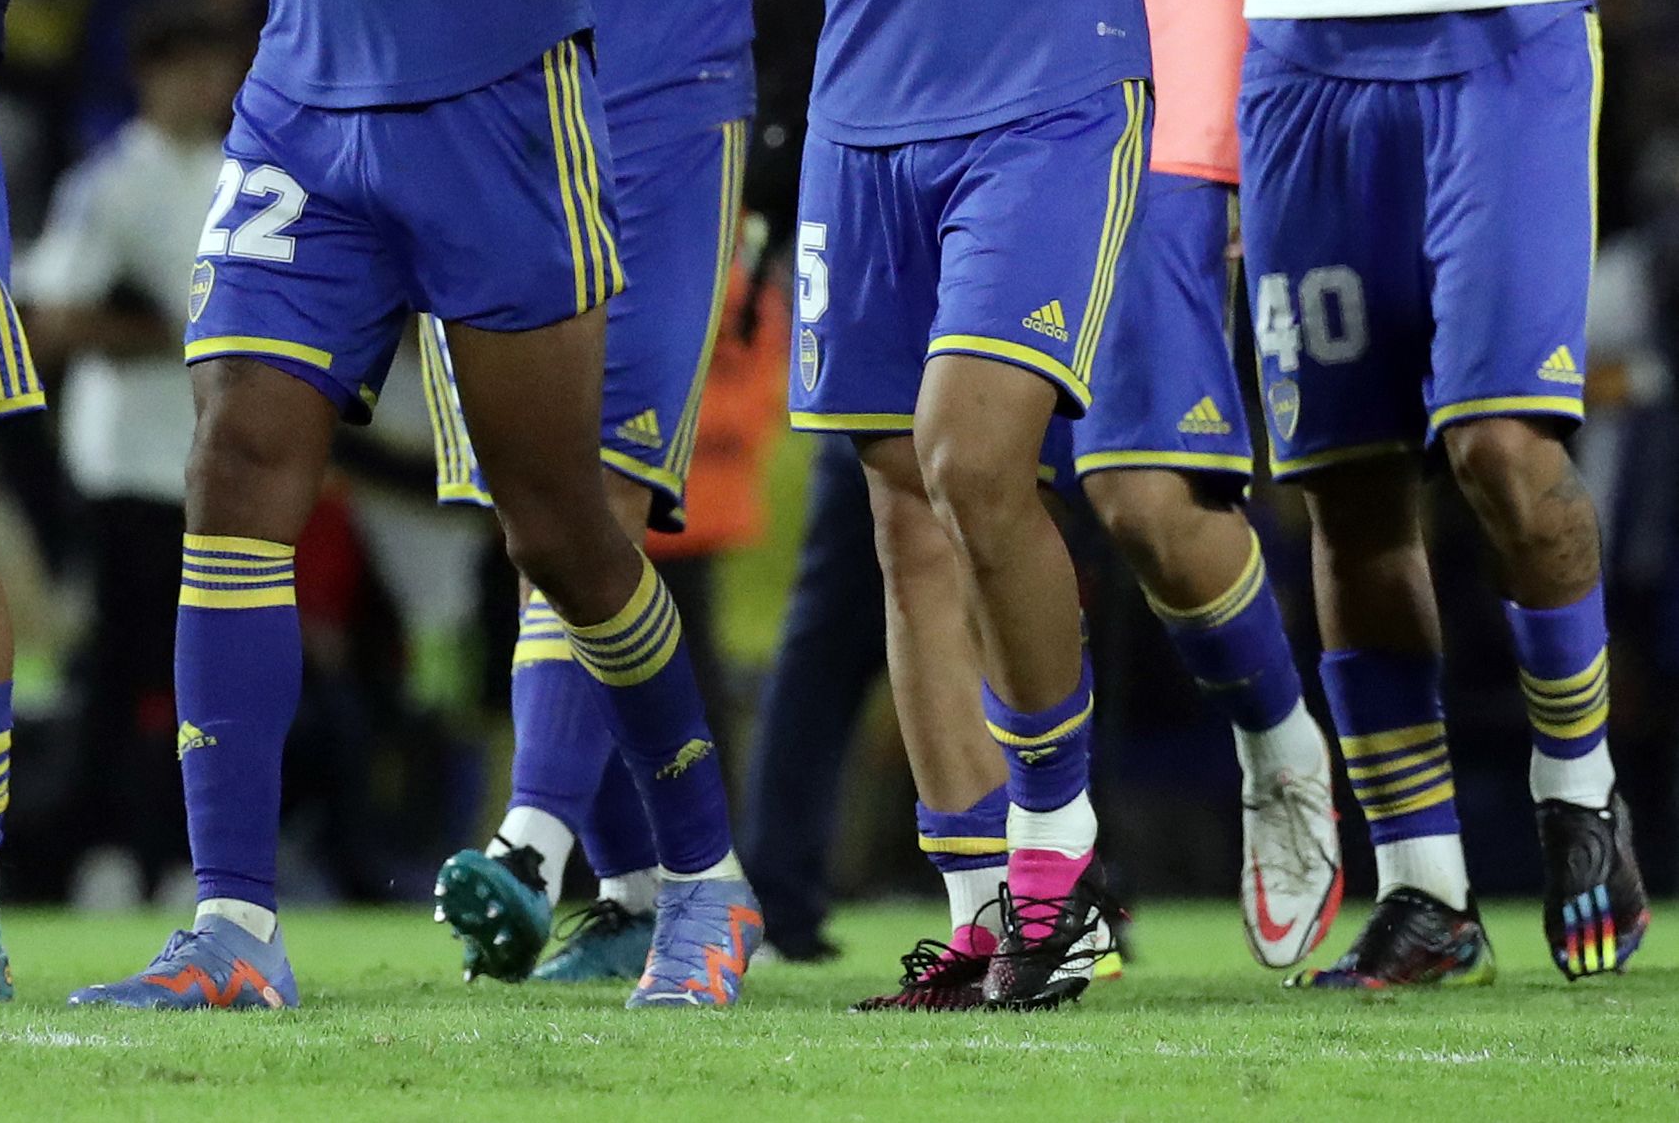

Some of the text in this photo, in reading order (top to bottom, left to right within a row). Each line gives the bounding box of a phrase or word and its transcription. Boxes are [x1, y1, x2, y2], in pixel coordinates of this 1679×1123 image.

[197, 152, 309, 263] 22
[797, 221, 829, 324] 5
[1256, 263, 1369, 373] 40
[1022, 317, 1070, 343] adidas
